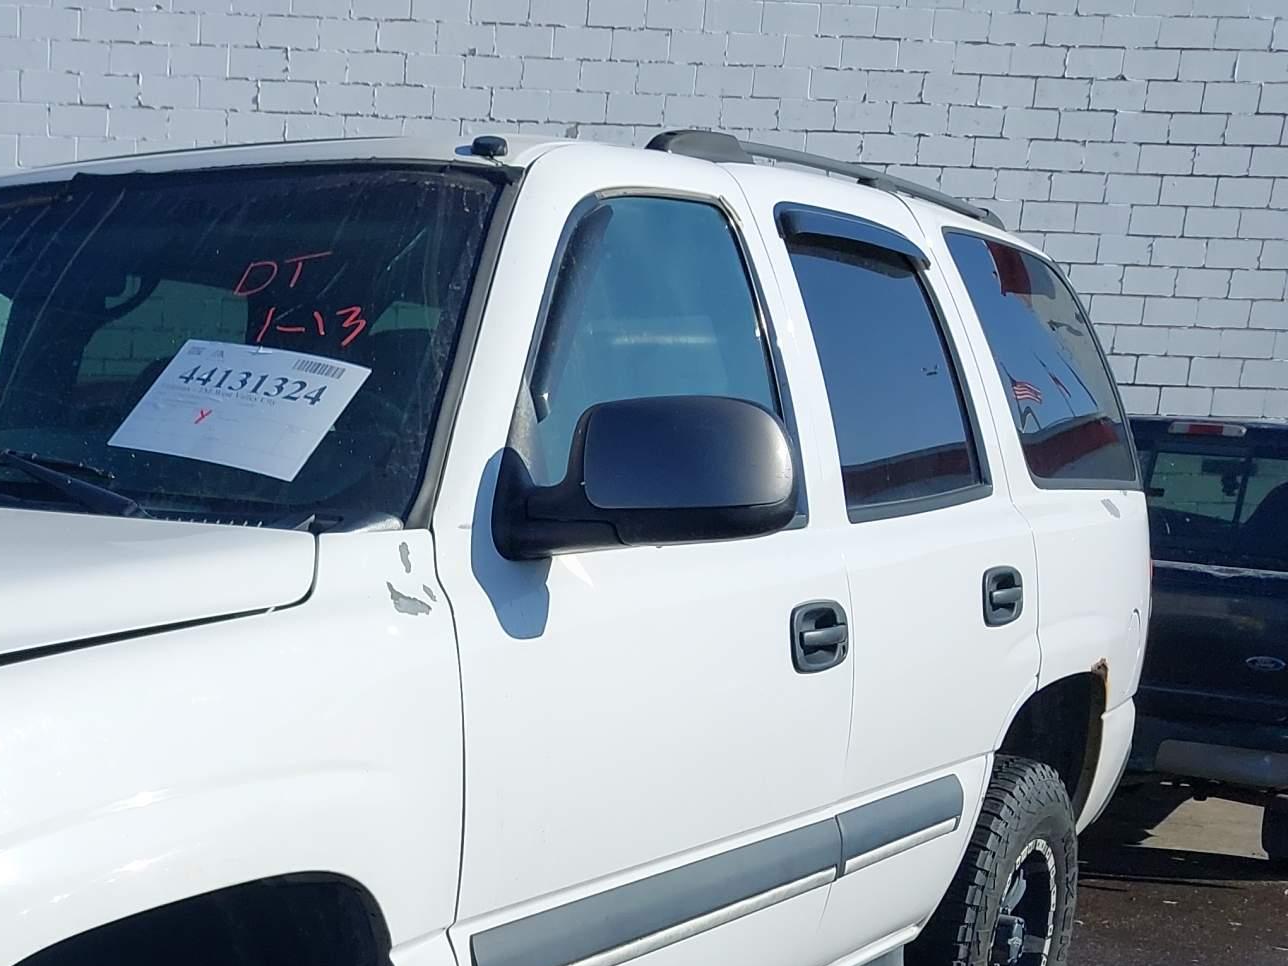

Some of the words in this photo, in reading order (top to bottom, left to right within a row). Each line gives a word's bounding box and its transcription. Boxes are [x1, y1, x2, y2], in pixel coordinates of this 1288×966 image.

[233, 251, 332, 296] DT
[256, 306, 367, 346] 1-13
[179, 365, 327, 405] 44131324
